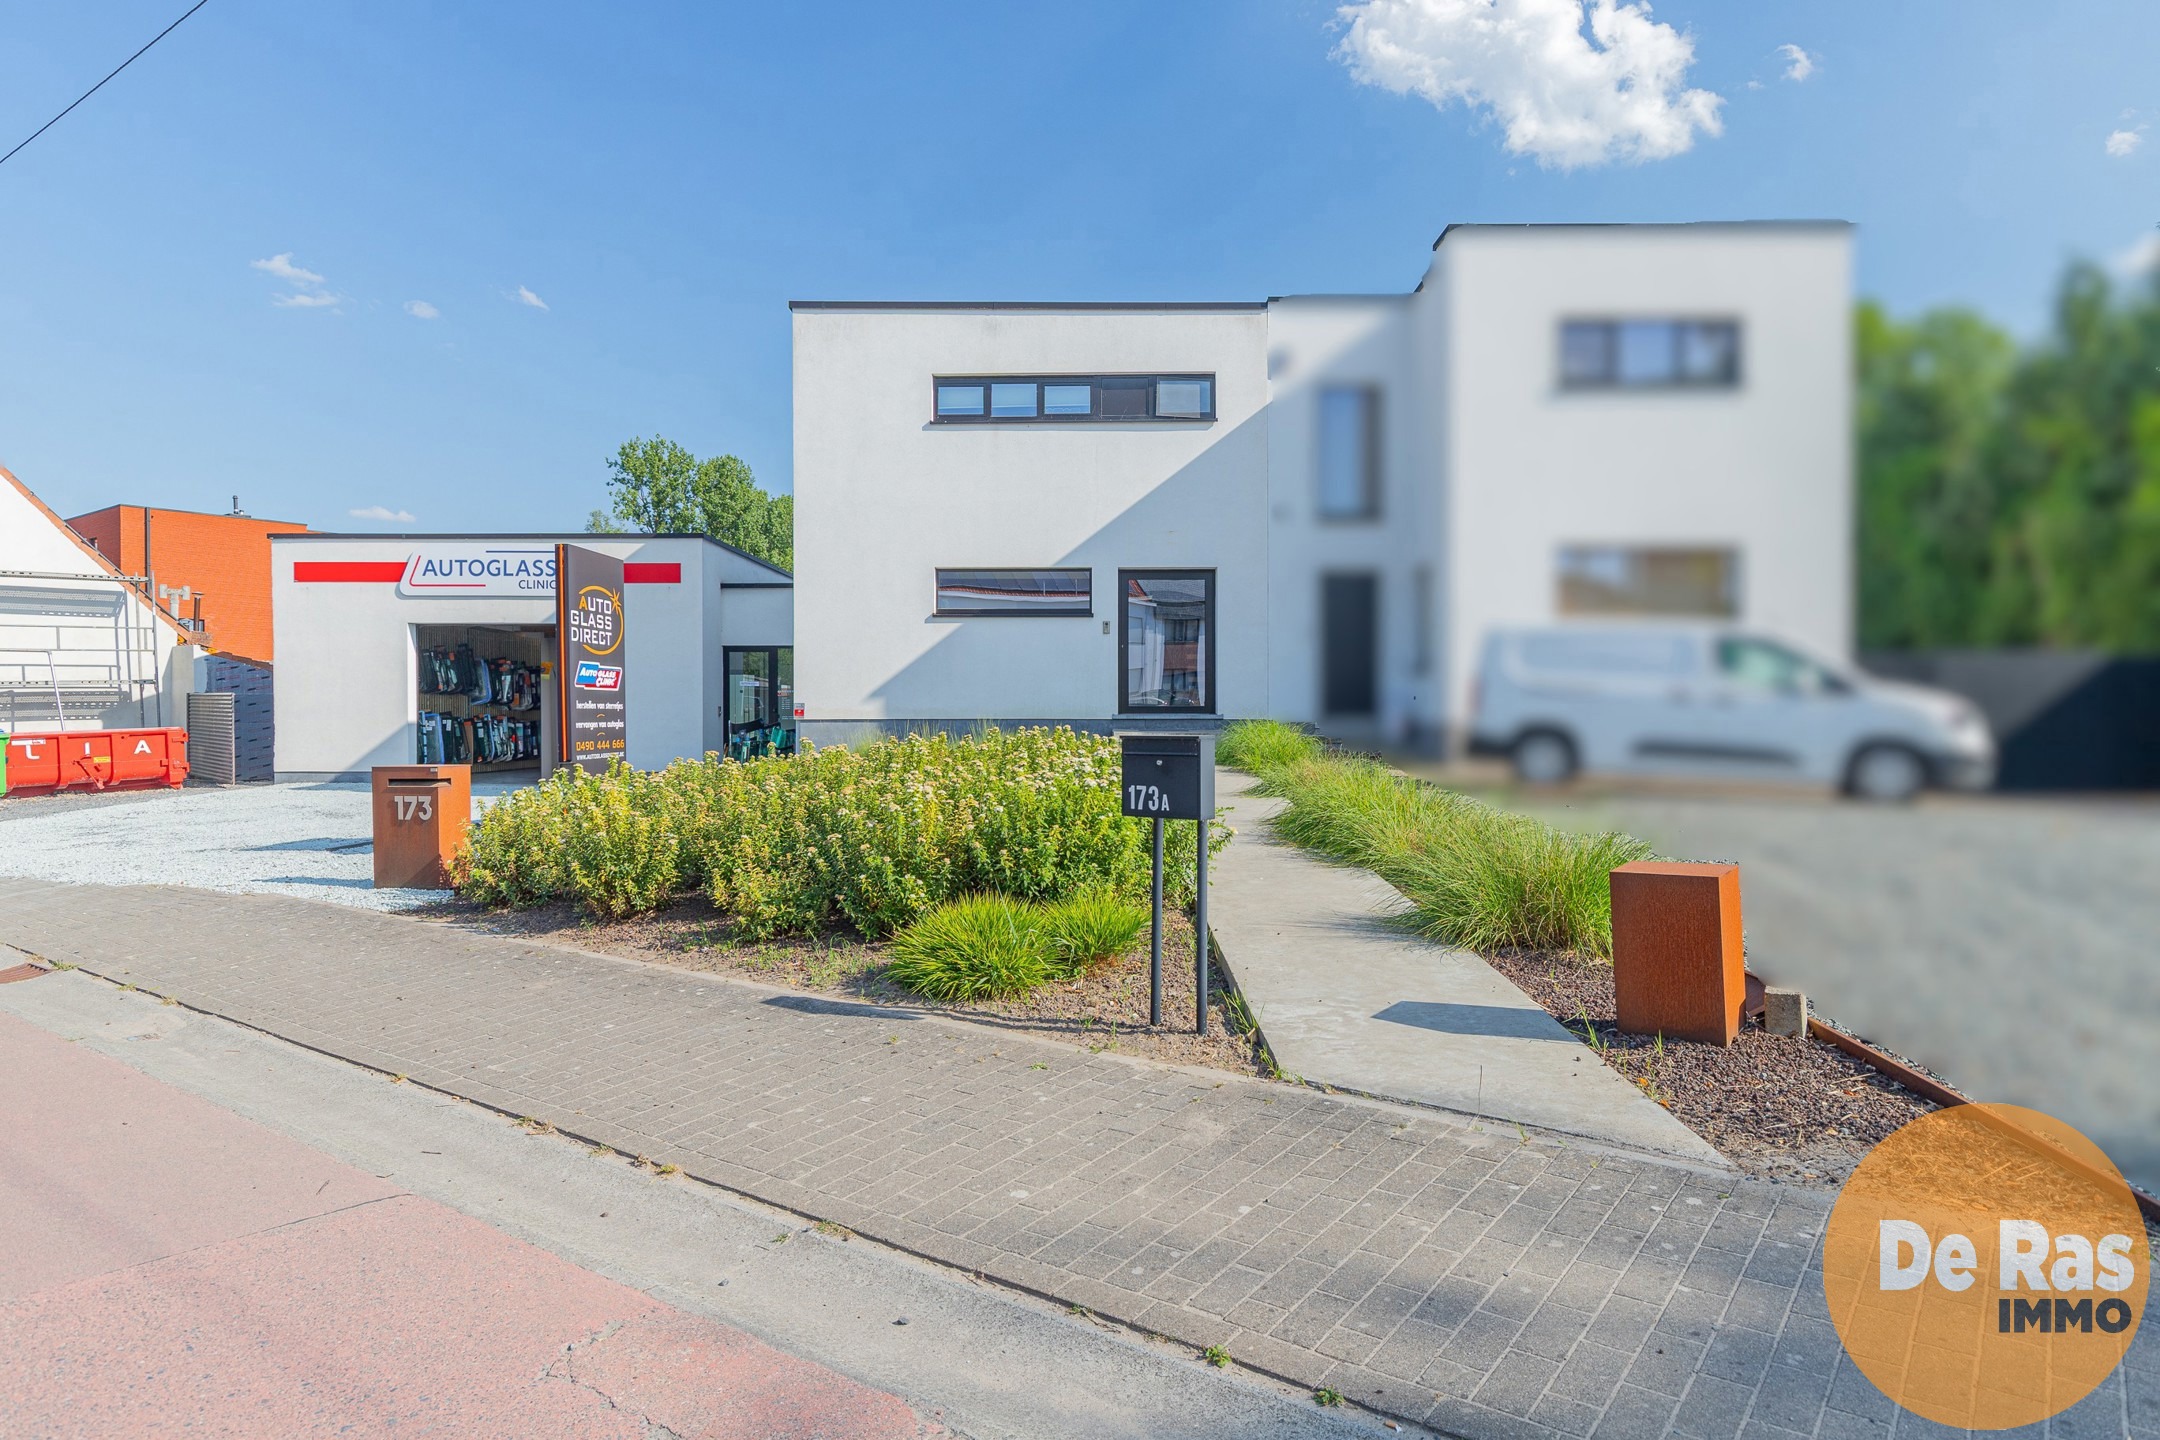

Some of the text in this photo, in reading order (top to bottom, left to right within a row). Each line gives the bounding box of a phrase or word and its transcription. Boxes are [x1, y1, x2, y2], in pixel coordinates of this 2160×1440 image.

[422, 559, 557, 577] AUTOGLASS
[518, 579, 557, 590] CLINIC
[579, 595, 612, 614] AUTO
[570, 609, 612, 630] GLASS
[571, 626, 612, 646] DIRECT
[575, 721, 598, 730] vervangen
[607, 719, 624, 730] autoglas
[575, 739, 625, 751] 0490 444 666
[394, 795, 433, 820] 173
